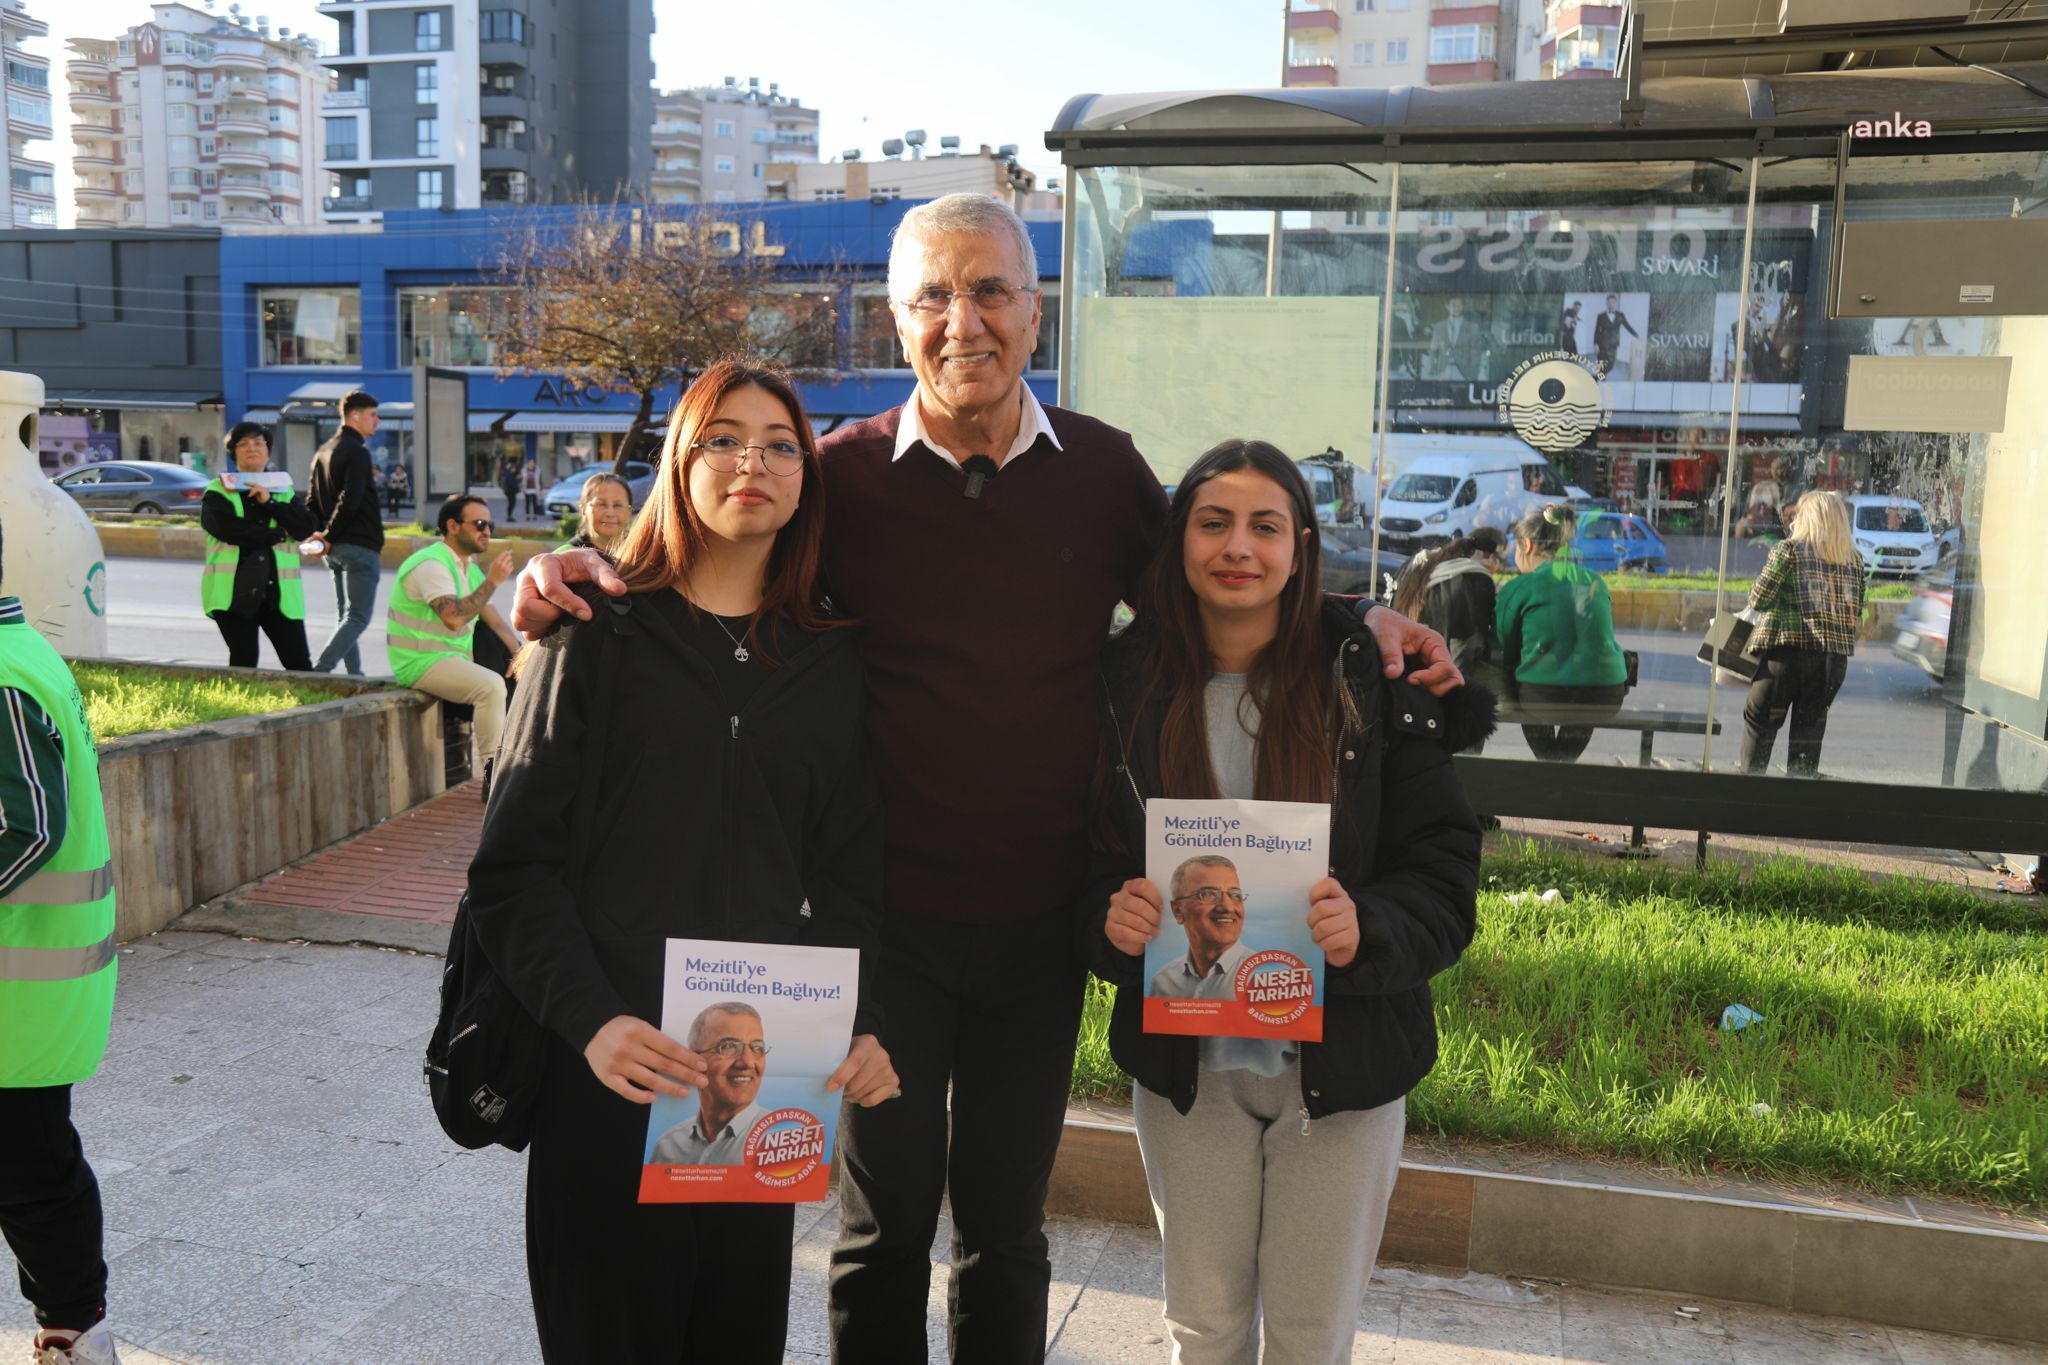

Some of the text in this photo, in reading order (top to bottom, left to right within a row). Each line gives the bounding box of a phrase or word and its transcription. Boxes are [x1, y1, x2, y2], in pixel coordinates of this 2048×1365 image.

[1164, 816, 1241, 833] Mezitli'ye
[1164, 832, 1312, 854] Gönülden Bağlıyız!
[685, 958, 767, 979] Mezitli'ye
[1237, 953, 1298, 992] BAĞIMSIZ BAŞKAN
[1253, 967, 1313, 988] NEŞET
[684, 976, 841, 1002] Gönülden Bağlıyız!
[1247, 984, 1313, 1003] TARHAN
[1247, 1000, 1309, 1025] BAĞIMSIZ ADAY
[746, 1111, 813, 1156] BAĞIMSIZ BAŞKAN
[764, 1123, 825, 1150] NEŞET
[756, 1140, 823, 1166] TARHAN
[753, 1159, 818, 1187] BAĞIMSIZ ADAY
